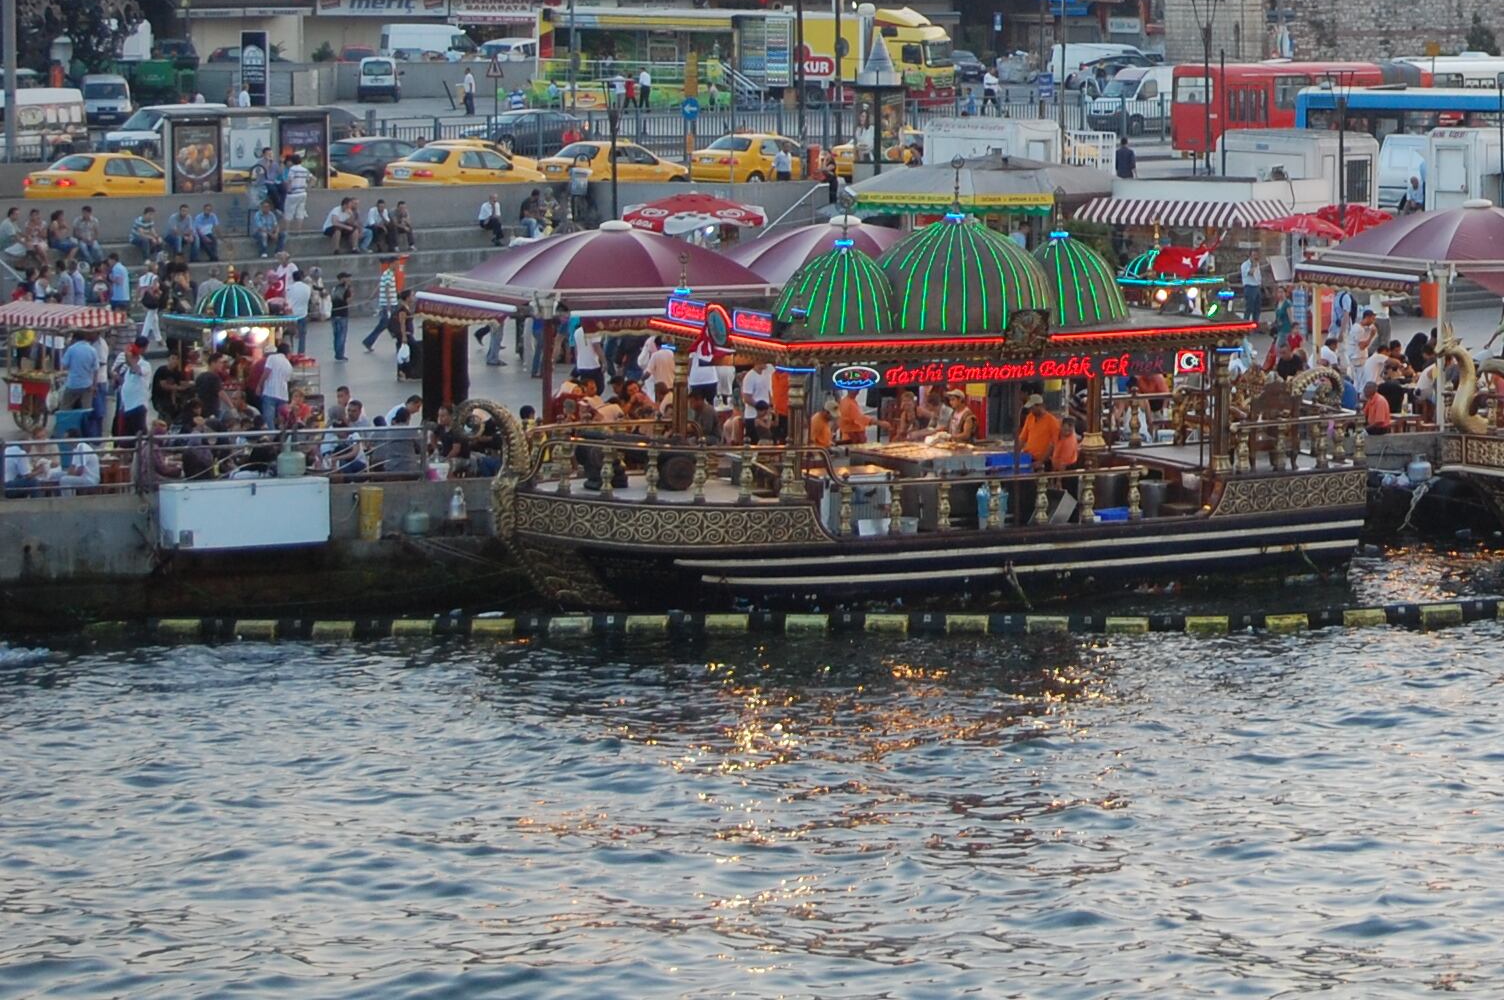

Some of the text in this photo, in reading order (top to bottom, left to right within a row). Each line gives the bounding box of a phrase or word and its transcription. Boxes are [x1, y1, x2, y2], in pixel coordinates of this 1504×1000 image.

[885, 363, 944, 387] Tarihi
[947, 359, 1036, 383] Eminönü
[1039, 355, 1096, 379] Balık
